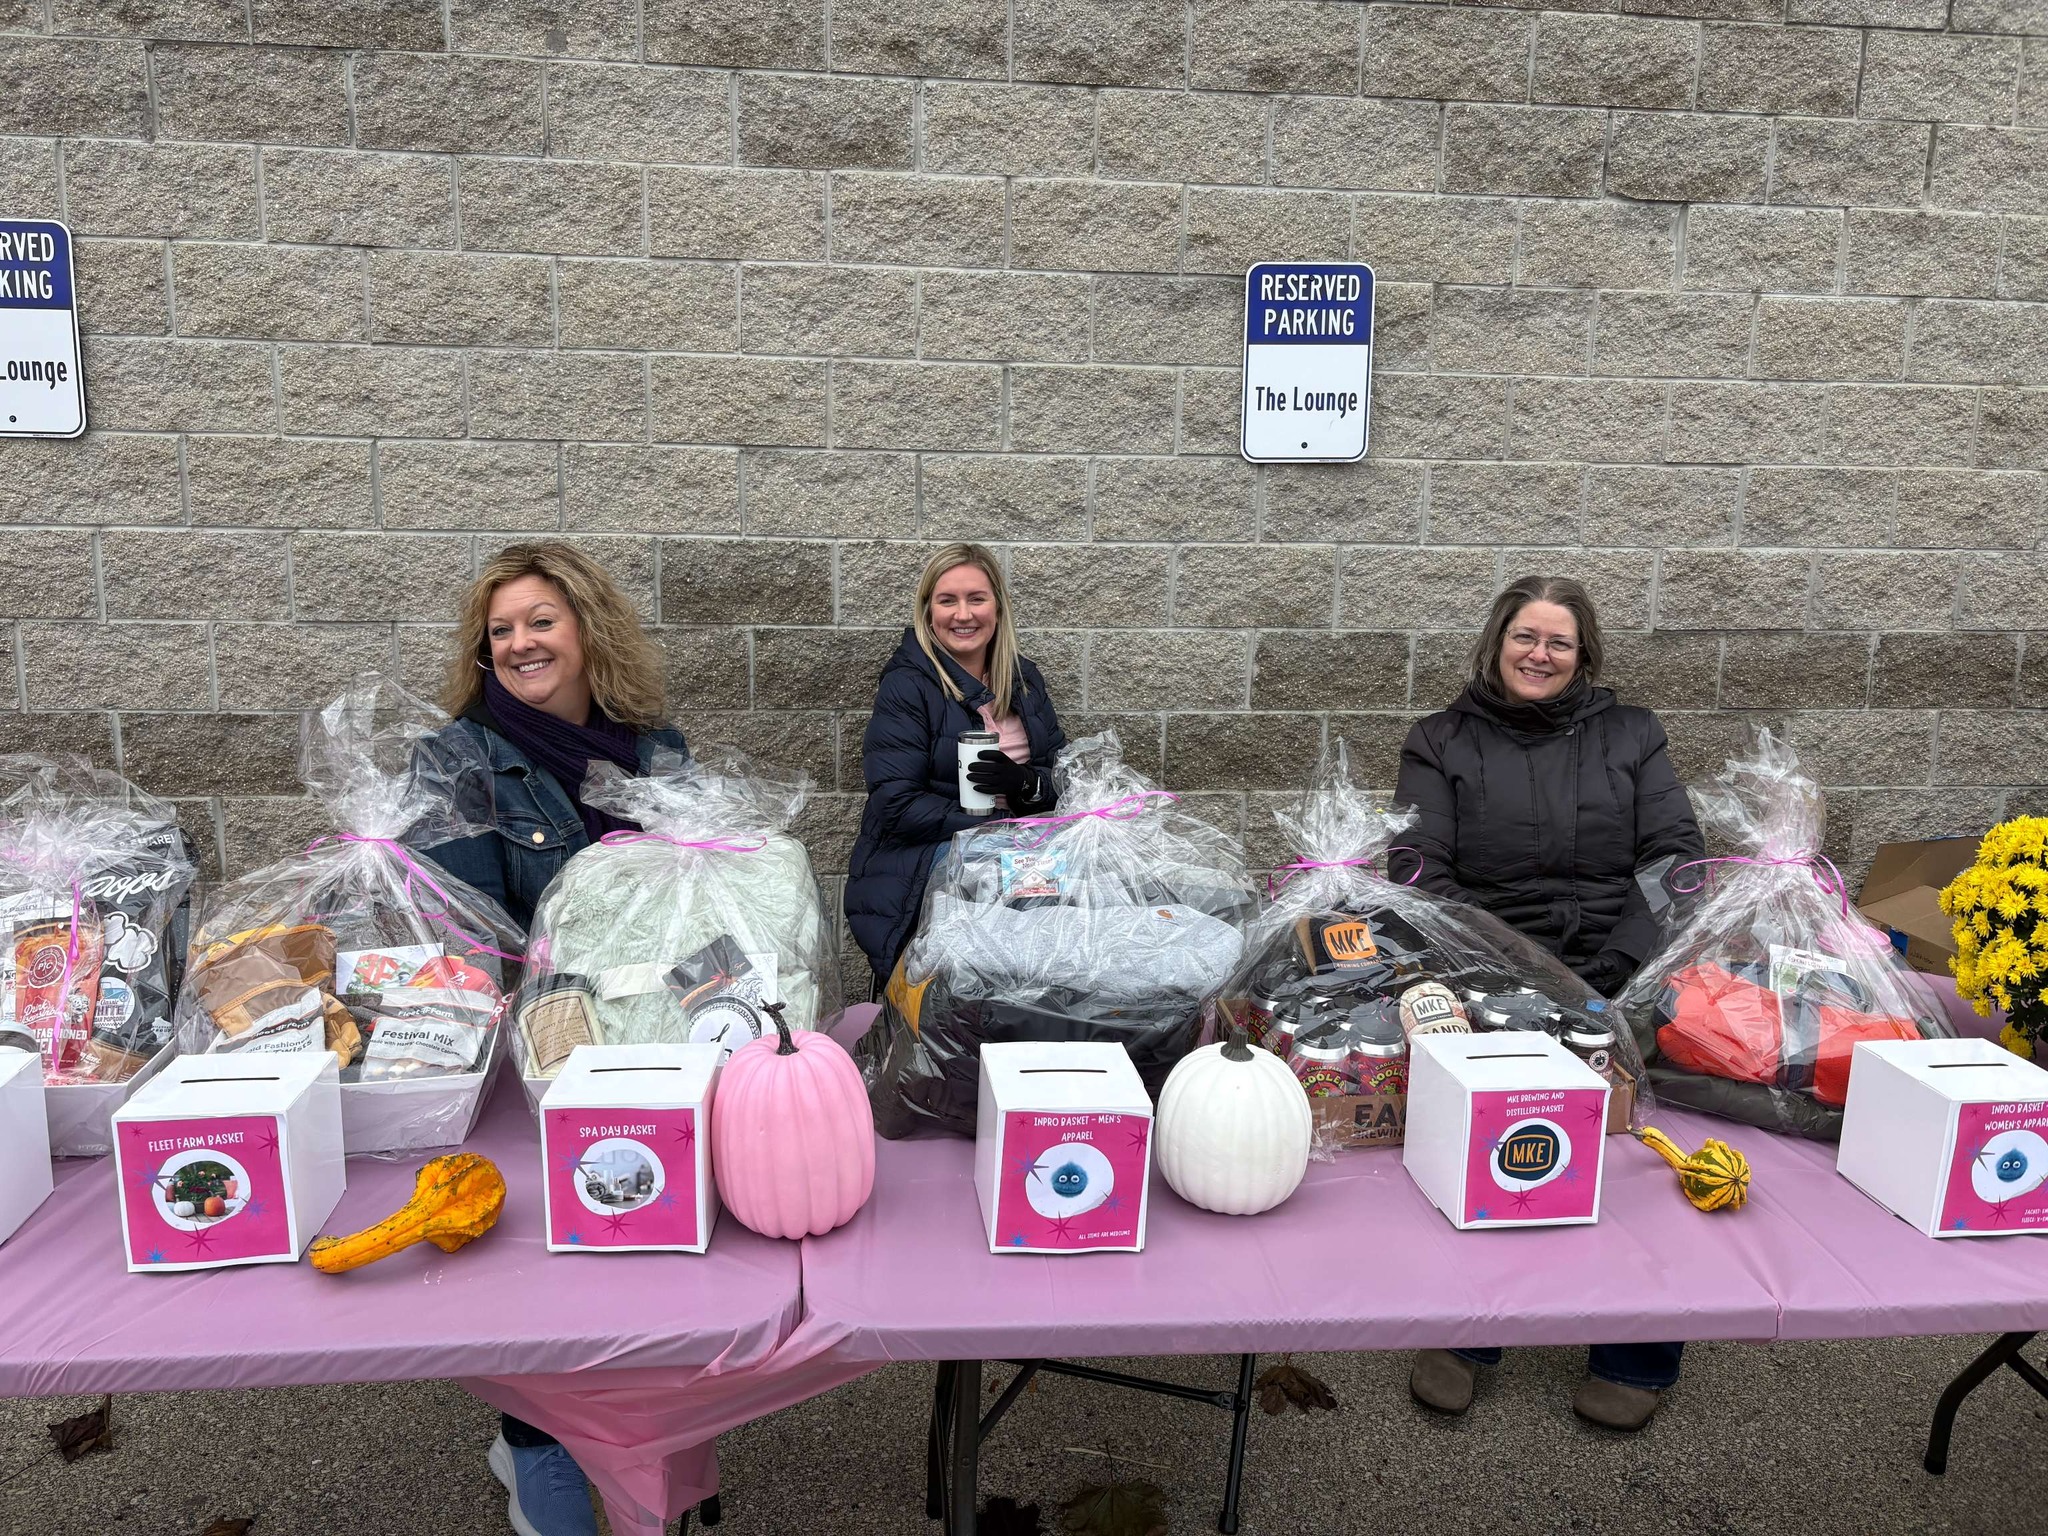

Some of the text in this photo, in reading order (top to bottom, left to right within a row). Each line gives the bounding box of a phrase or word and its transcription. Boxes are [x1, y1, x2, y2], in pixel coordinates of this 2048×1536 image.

[1261, 274, 1361, 301] RESERVED
[1264, 308, 1355, 336] PARKING
[1255, 386, 1358, 419] The Lounge
[1329, 928, 1370, 955] MKE
[95, 1005, 125, 1016] HITE
[1416, 998, 1446, 1016] MKE
[381, 1030, 455, 1047] Festival Mix
[1301, 1073, 1346, 1089] KOOLER
[1507, 1092, 1565, 1103] MKE BREWING AND
[1506, 1104, 1565, 1117] DISTILLERY BASKET
[1991, 1102, 2045, 1115] INPRO BASKET
[1034, 1117, 1058, 1126] INPRO
[1060, 1116, 1089, 1126] BASKET
[1098, 1115, 1122, 1124] MEN'S
[1984, 1119, 2021, 1131] WOMEN'S
[579, 1125, 657, 1137] SPA DAY BASKET
[1061, 1131, 1093, 1141] APPAREL
[148, 1132, 244, 1152] FLEET FARM BASKET
[1513, 1143, 1546, 1164] MKE
